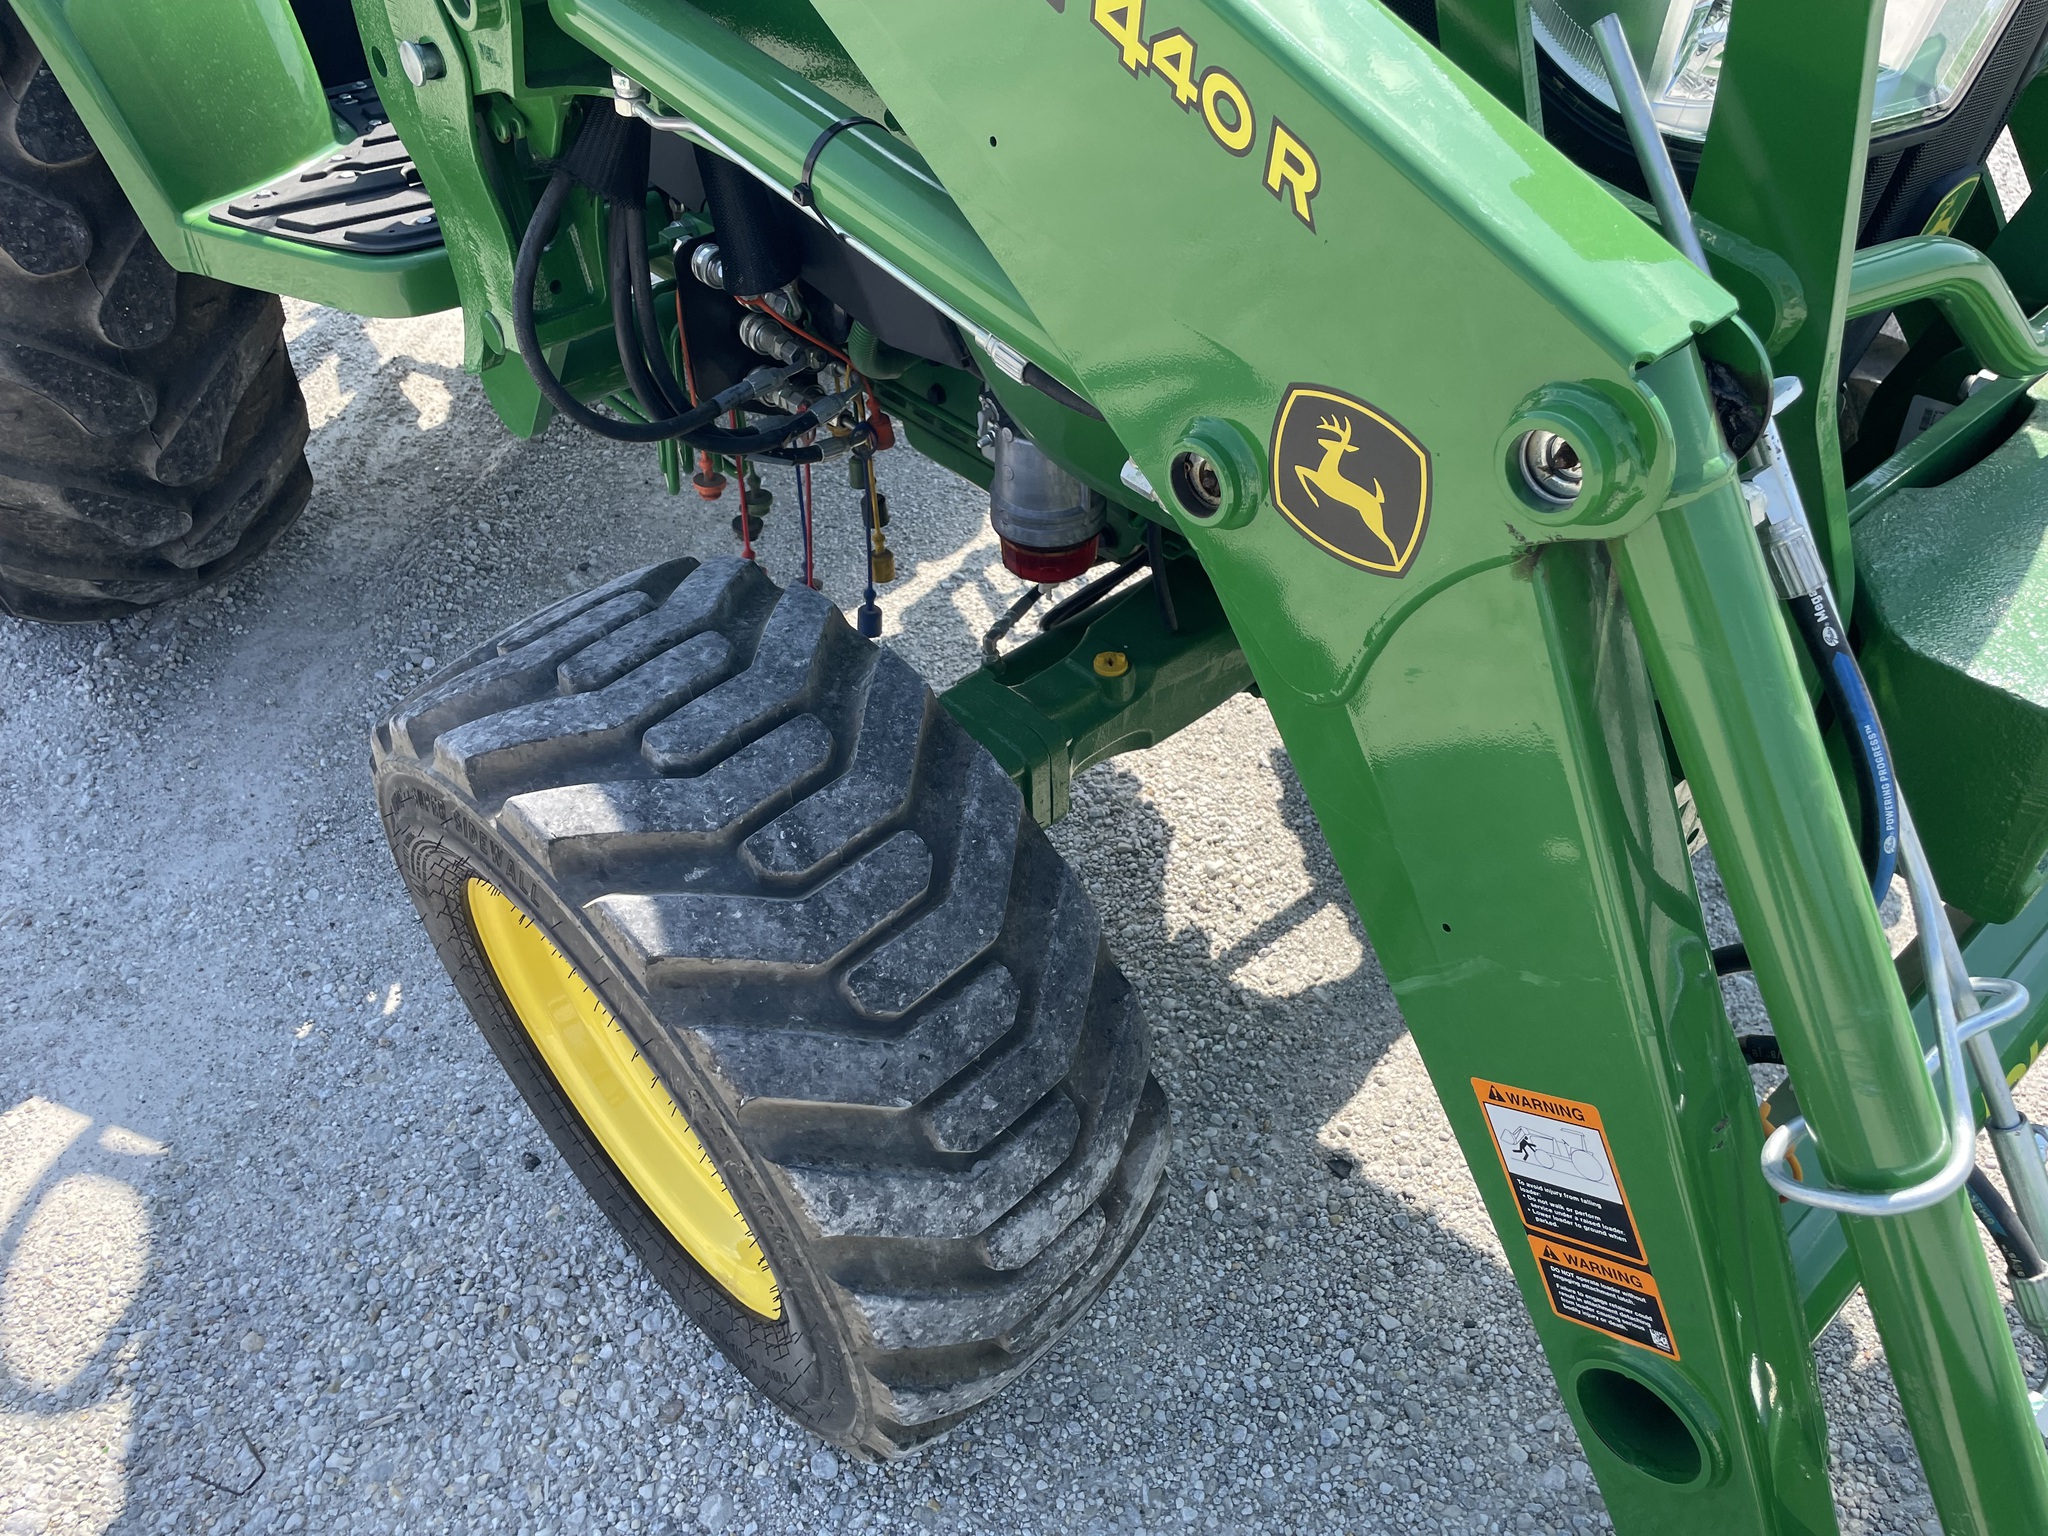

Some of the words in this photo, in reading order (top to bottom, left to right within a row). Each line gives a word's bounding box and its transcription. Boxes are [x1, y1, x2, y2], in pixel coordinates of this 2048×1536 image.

[1090, 0, 1256, 157] 440
[1881, 783, 1894, 831] POWERING
[452, 809, 540, 907] SIDEWALL
[1505, 1092, 1586, 1122] WARNING
[1526, 1182, 1543, 1192] avoid
[1544, 1186, 1562, 1198] injury
[1563, 1192, 1580, 1202] from
[1580, 1197, 1602, 1210] falling
[1549, 1202, 1565, 1211] walk
[1574, 1210, 1602, 1222] perform
[1530, 1202, 1553, 1213] service
[1554, 1210, 1573, 1219] under
[1580, 1217, 1601, 1228] raised
[1602, 1223, 1626, 1236] loader.
[1532, 1208, 1552, 1219] Lower
[1552, 1215, 1573, 1226] loader
[1574, 1221, 1582, 1229] to
[1583, 1225, 1608, 1237] ground
[1608, 1232, 1628, 1242] when
[1535, 1216, 1560, 1228] parked.
[1550, 1266, 1560, 1274] DO
[1560, 1269, 1574, 1278] NOT
[1576, 1276, 1600, 1287] operate
[1600, 1282, 1620, 1294] loader
[1622, 1290, 1646, 1304] without
[1552, 1274, 1580, 1288] engaging
[1581, 1283, 1617, 1299] attachment
[1562, 1252, 1643, 1288] WARNING
[1556, 1282, 1576, 1294] Failure
[1584, 1294, 1608, 1306] engage
[1608, 1302, 1633, 1315] retainer
[1634, 1311, 1653, 1322] could
[1558, 1290, 1576, 1300] result
[1584, 1300, 1618, 1316] attachment
[1619, 1312, 1652, 1328] detaching
[1560, 1296, 1576, 1306] from
[1576, 1302, 1595, 1312] loader
[1596, 1310, 1621, 1322] causing
[1622, 1320, 1646, 1332] serious
[1562, 1303, 1581, 1314] bodily
[1582, 1310, 1599, 1320] injury
